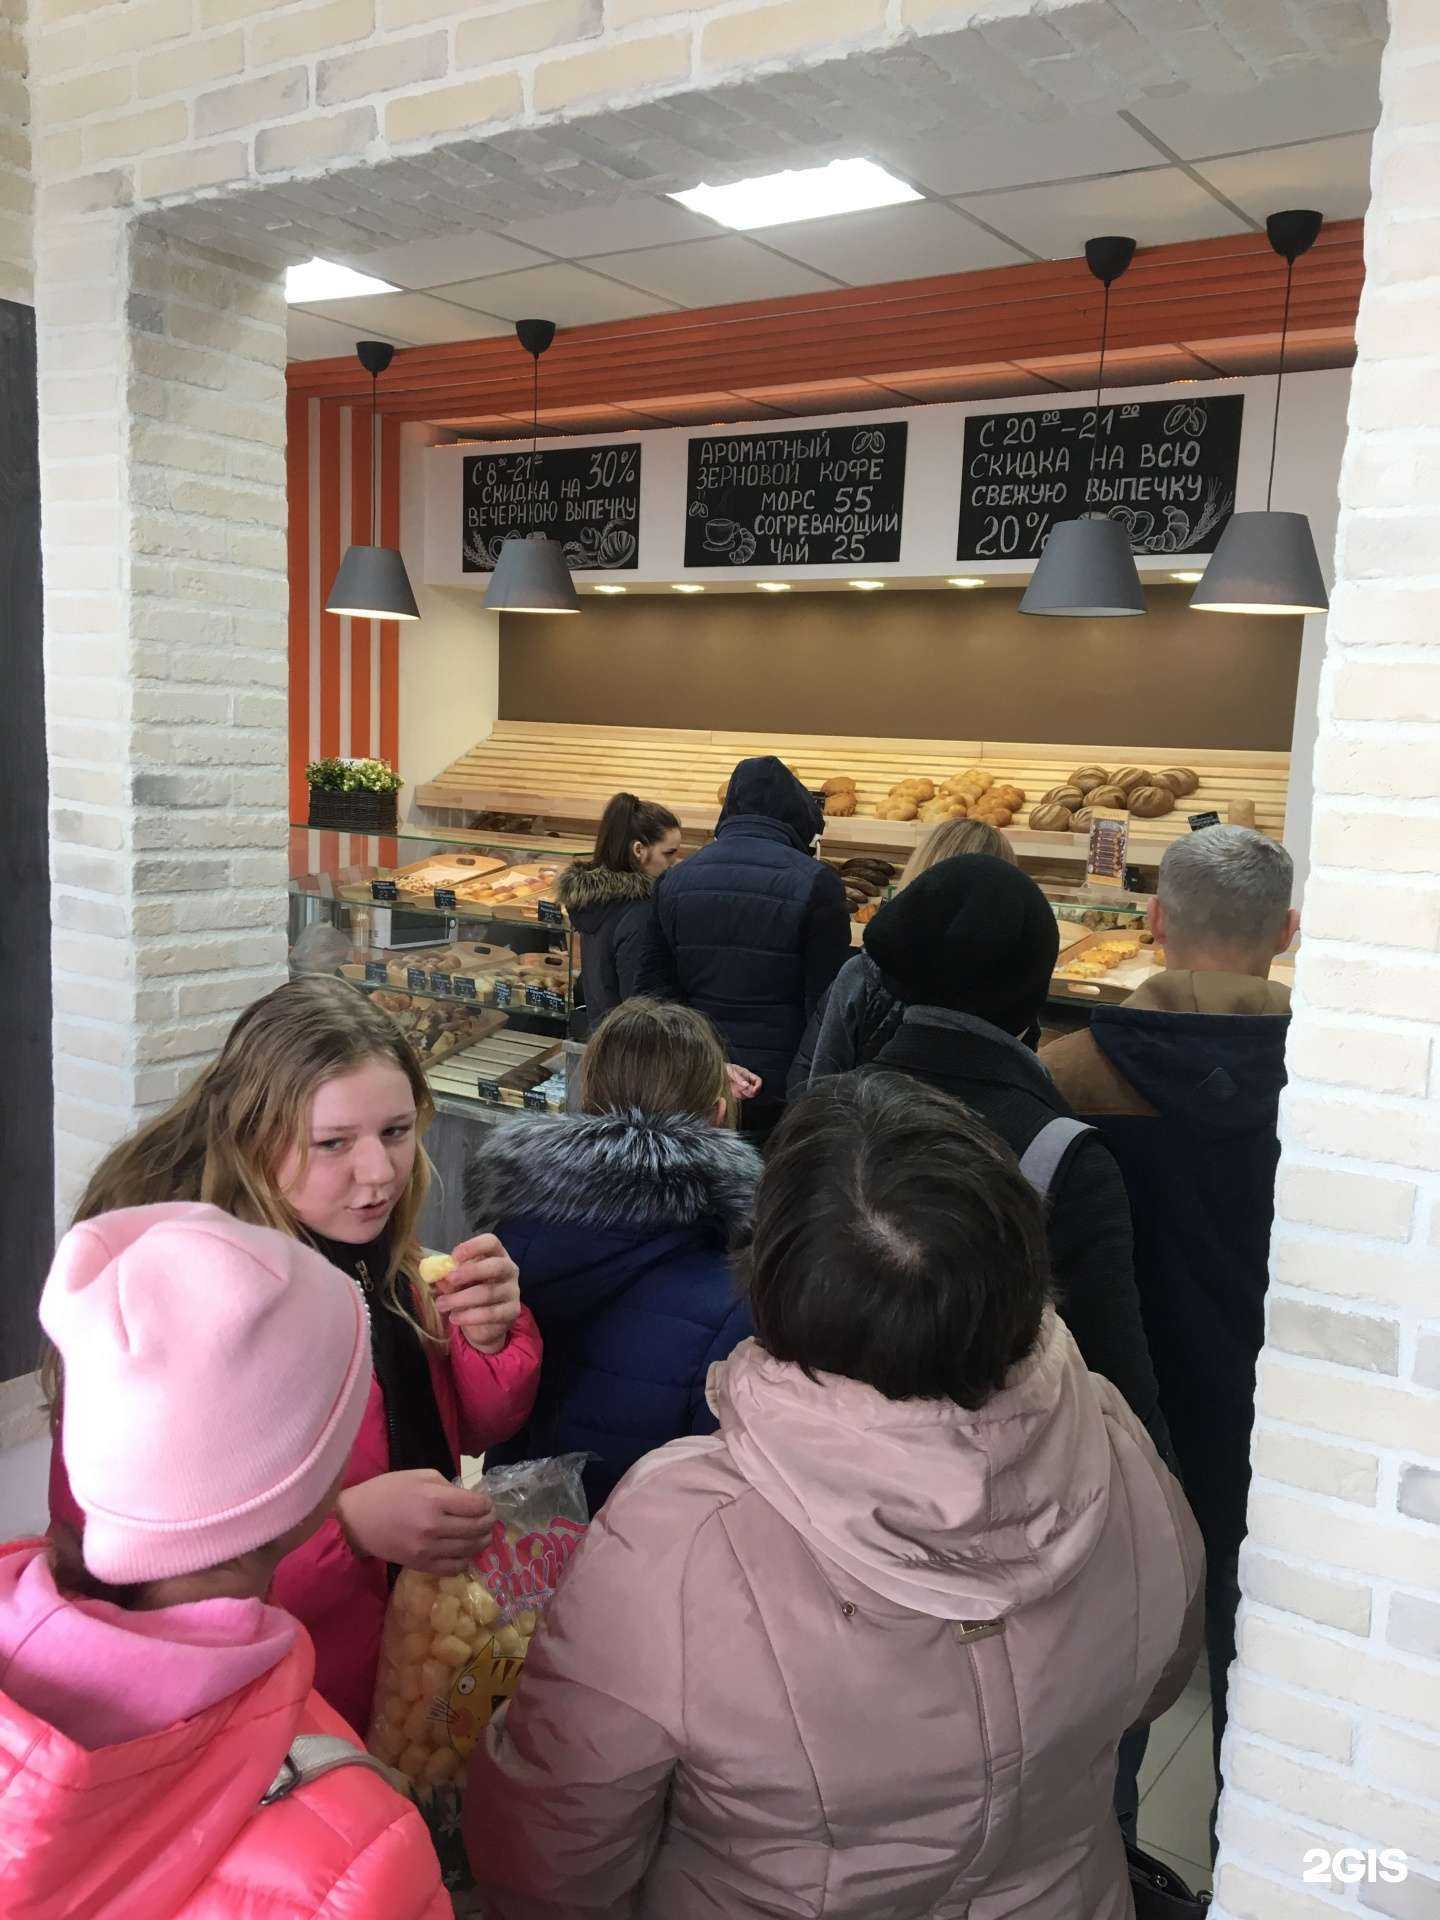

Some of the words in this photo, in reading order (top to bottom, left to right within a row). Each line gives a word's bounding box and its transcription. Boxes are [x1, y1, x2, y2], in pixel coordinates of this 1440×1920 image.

[700, 430, 832, 465] АРОМАТНЫЙ
[979, 420, 995, 448] С
[586, 449, 637, 490] 30%
[696, 459, 800, 490] ЗЕРНОВОЙ
[819, 458, 884, 483] КОФЕ
[970, 447, 1070, 479] СКИДКА
[1090, 444, 1124, 471] НА
[1140, 440, 1201, 468] ВСЮ
[482, 479, 549, 504] СКИДКА
[561, 478, 581, 499] НА
[761, 489, 816, 512] МОРС
[833, 485, 874, 513] 55
[971, 482, 1067, 507] СВЕЖУЮ
[1085, 474, 1203, 503] ВЫПЕЧКУ
[468, 500, 558, 528] ВЕЧЕРНЮЮ
[565, 496, 637, 522] ВЫПЕЧКУ
[771, 537, 809, 564] ЧАЙ
[831, 534, 866, 562] 25
